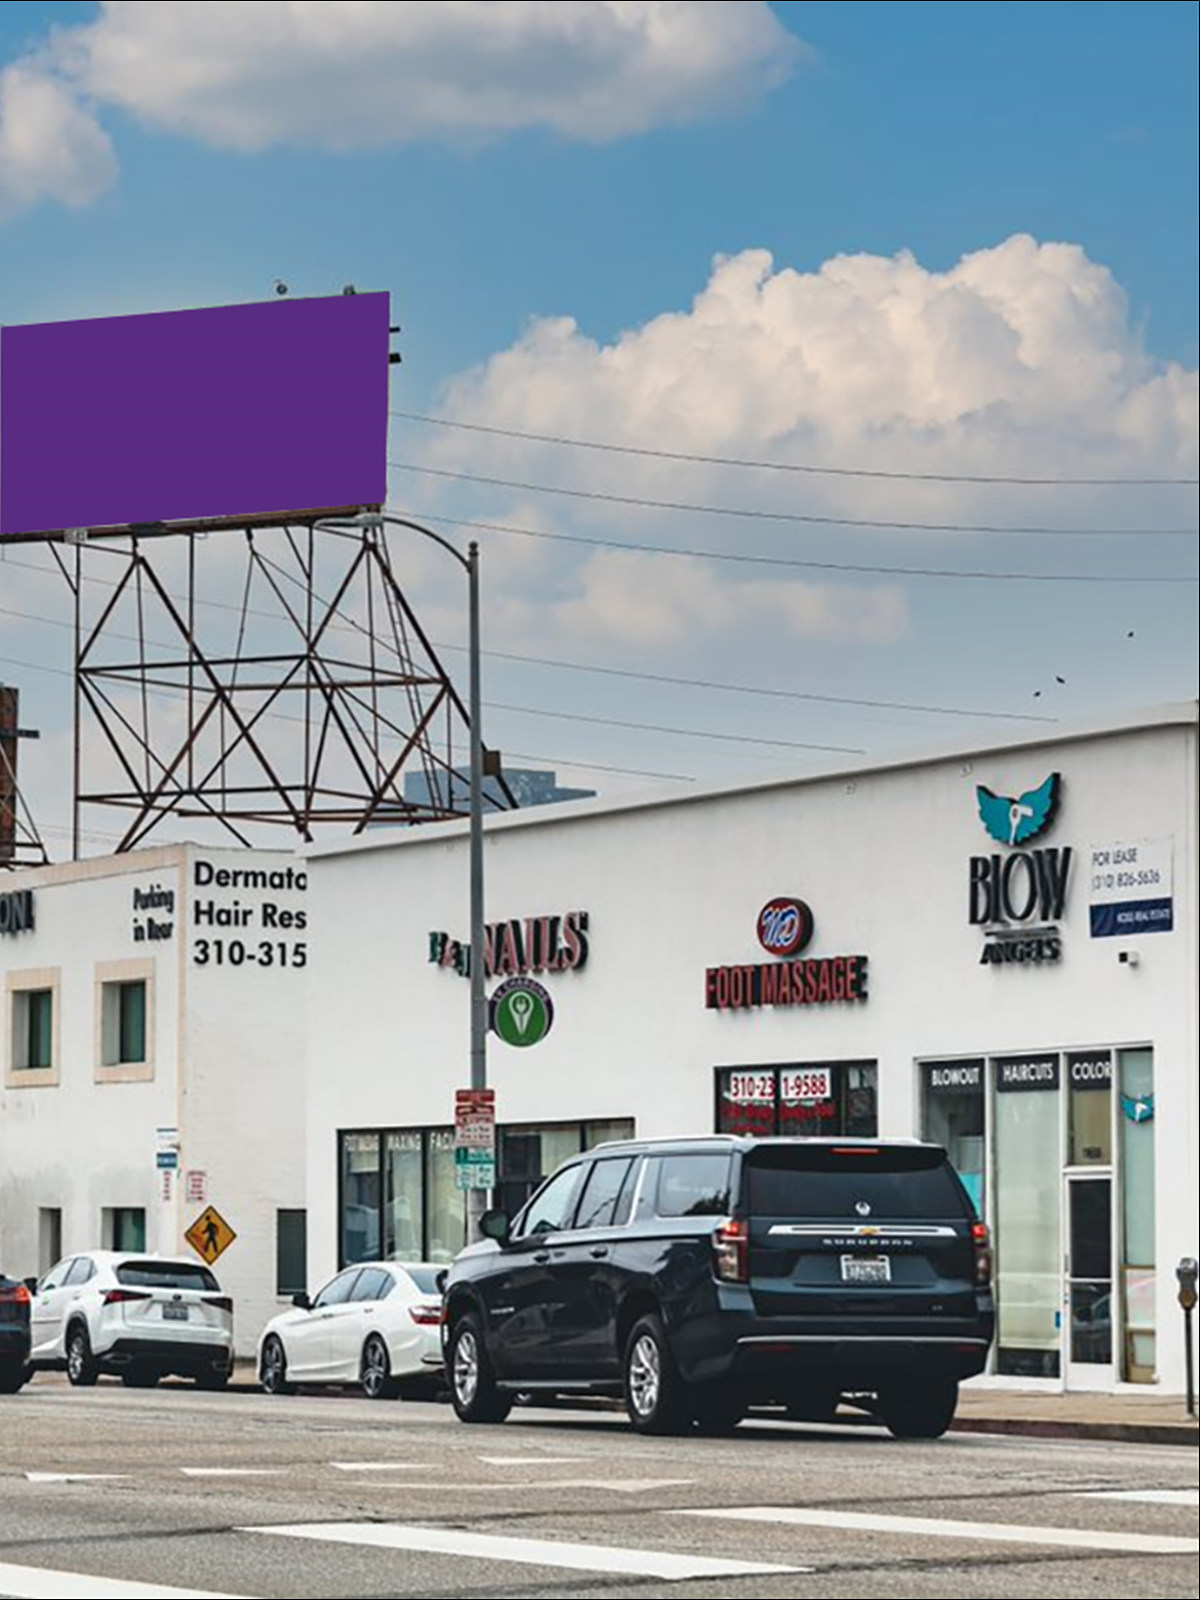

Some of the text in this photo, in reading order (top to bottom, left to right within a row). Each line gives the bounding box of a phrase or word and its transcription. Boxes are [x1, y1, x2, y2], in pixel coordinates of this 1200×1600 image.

[1092, 848, 1137, 866] FOR LEASE
[133, 884, 174, 913] Parking
[969, 848, 1072, 925] BLOW
[194, 900, 307, 929] Hair Res
[133, 918, 145, 941] in
[193, 939, 307, 967] 310-315
[483, 912, 589, 977] NAILS
[980, 938, 1062, 964] ANGELS
[706, 956, 864, 1008] FOOT MASSAGE
[931, 1062, 1110, 1086] BLOWOUT HAIRCUTS COLOR
